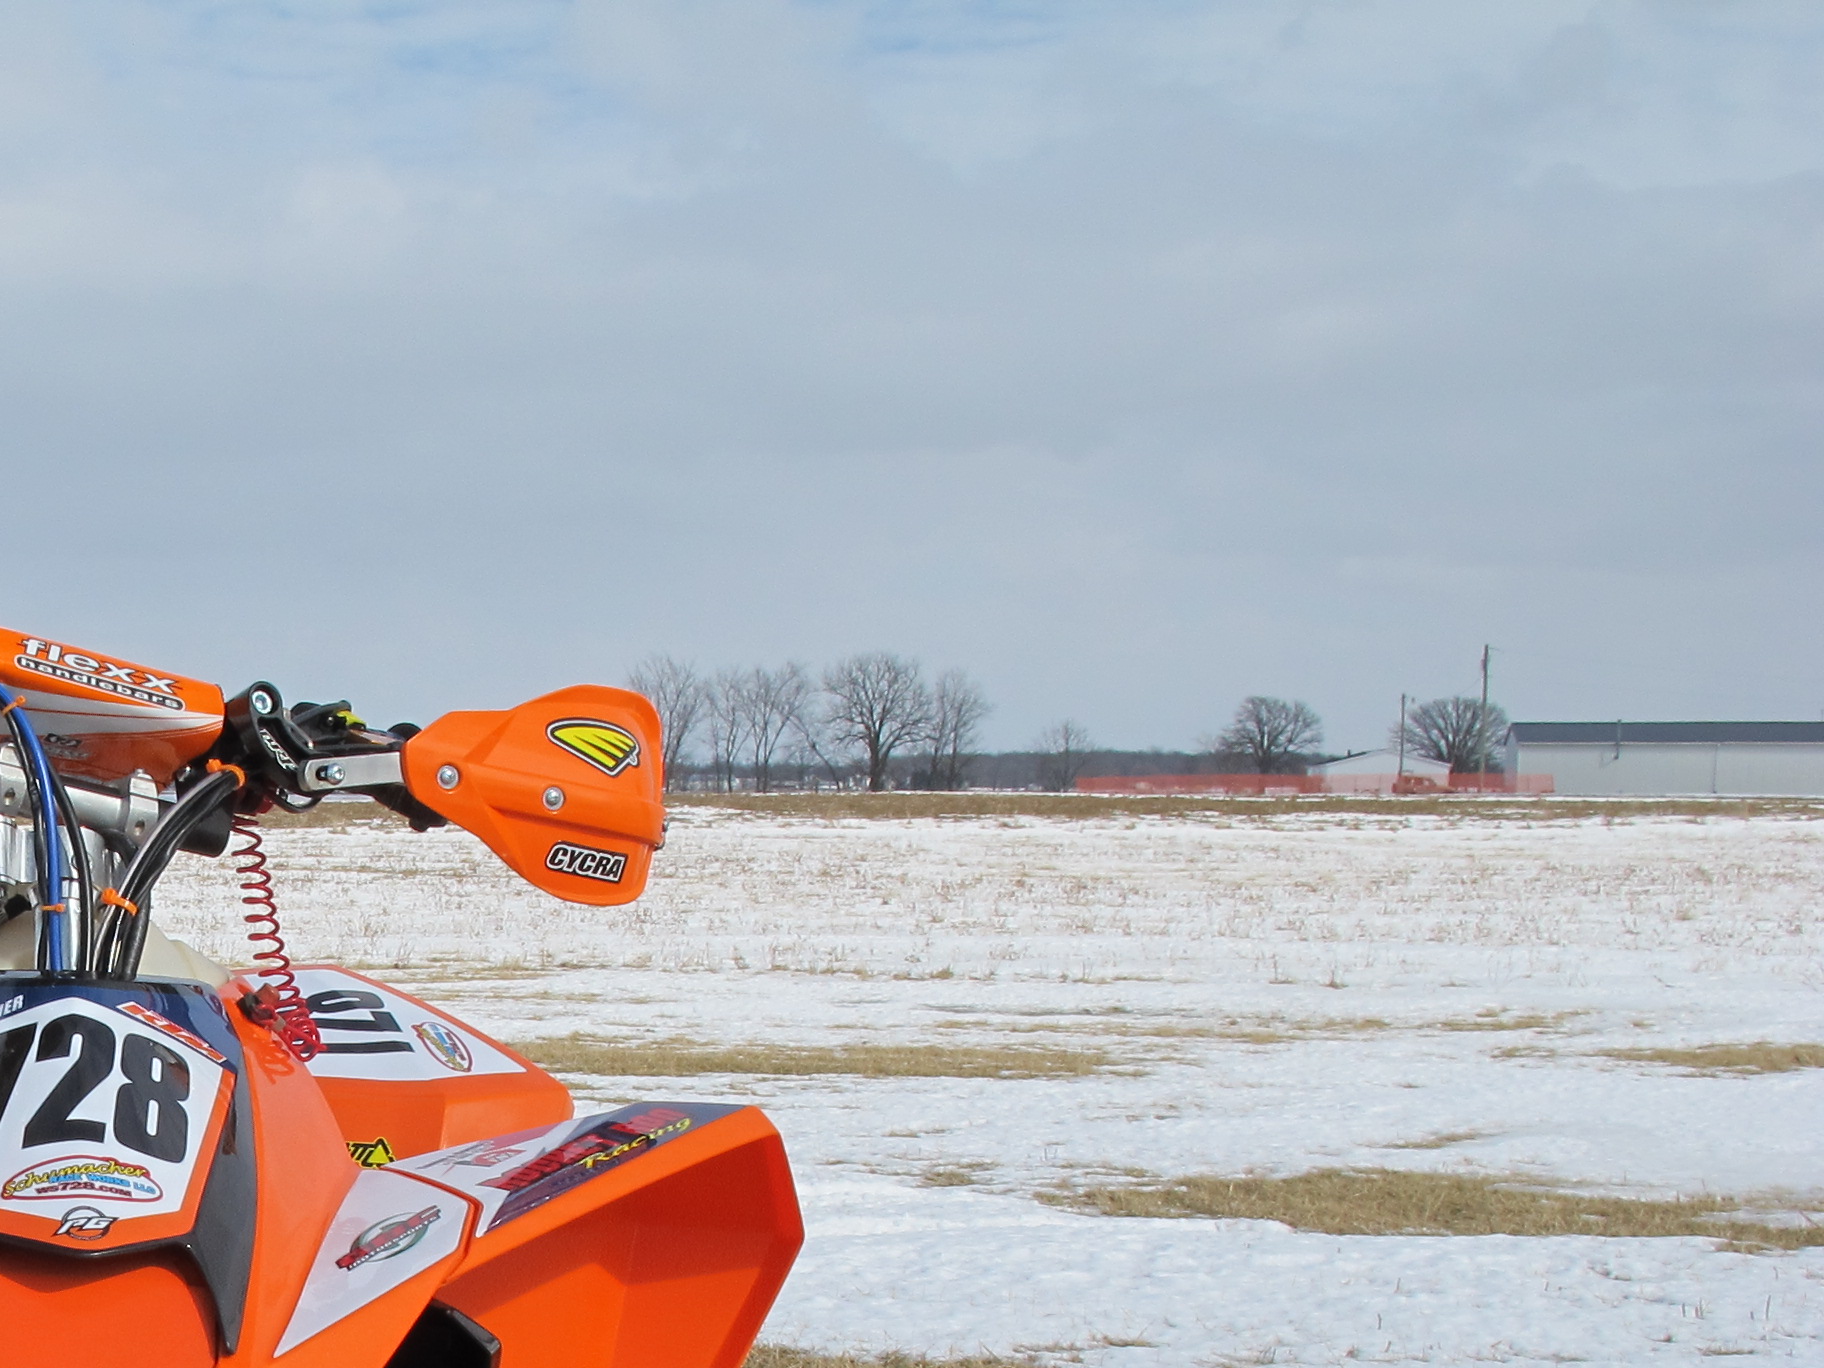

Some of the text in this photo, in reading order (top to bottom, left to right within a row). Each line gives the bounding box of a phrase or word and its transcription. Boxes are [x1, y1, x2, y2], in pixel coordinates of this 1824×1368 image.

[20, 657, 180, 709] handlebars
[22, 637, 177, 694] flexx
[547, 844, 627, 881] CYCRA
[578, 1117, 693, 1169] Racing
[2, 1160, 148, 1198] Schumacher
[133, 1181, 157, 1196] LLC
